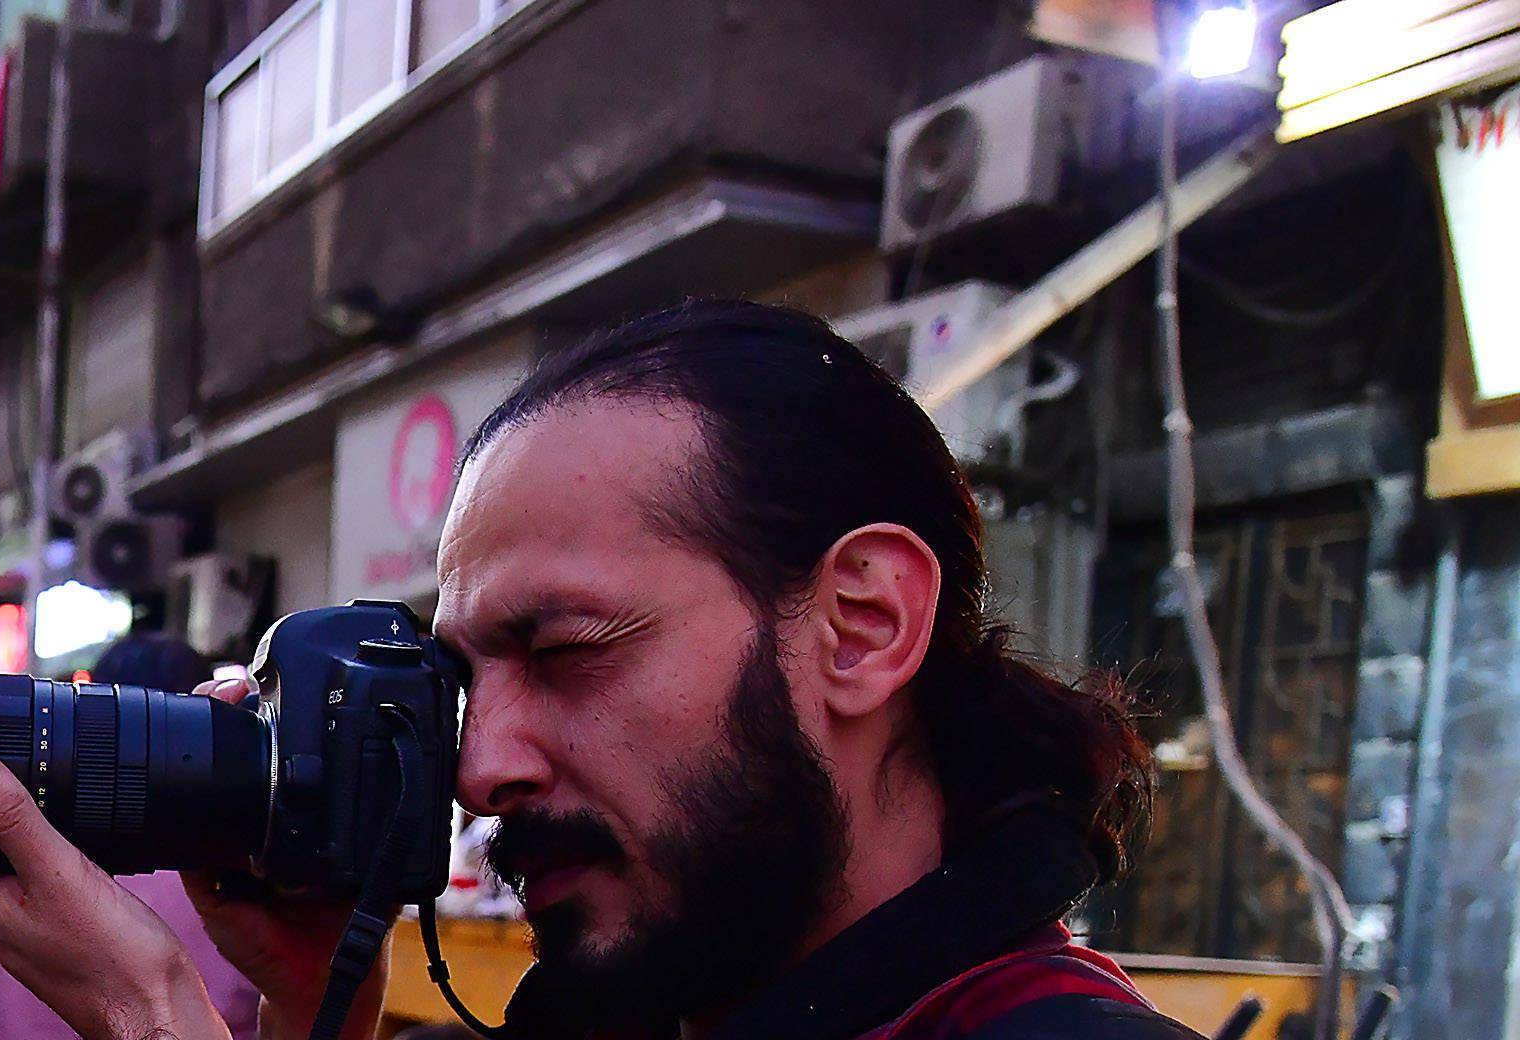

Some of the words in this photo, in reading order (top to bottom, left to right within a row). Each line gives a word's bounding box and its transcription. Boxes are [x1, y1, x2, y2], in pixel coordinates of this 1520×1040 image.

[329, 689, 343, 704] EOS
[40, 740, 48, 750] 50
[39, 761, 47, 772] 20
